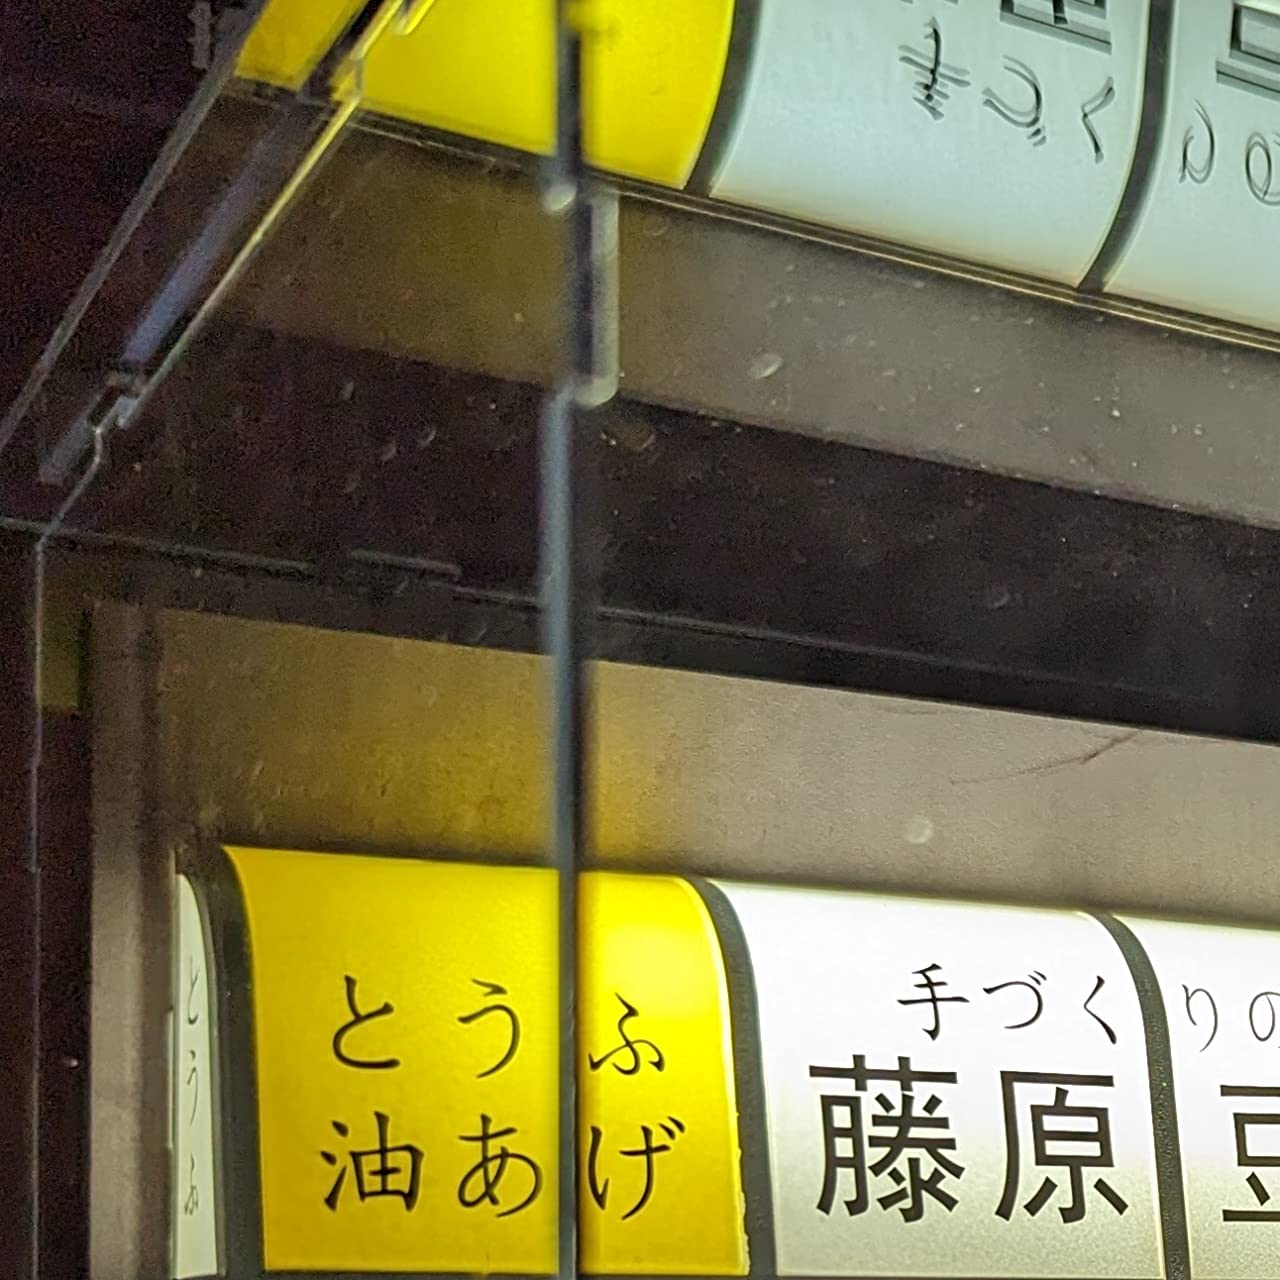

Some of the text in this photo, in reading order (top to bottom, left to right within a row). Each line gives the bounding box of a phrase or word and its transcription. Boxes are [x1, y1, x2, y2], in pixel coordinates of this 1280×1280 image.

[331, 975, 666, 1077] とうふ
[321, 1111, 686, 1221] 油あげ
